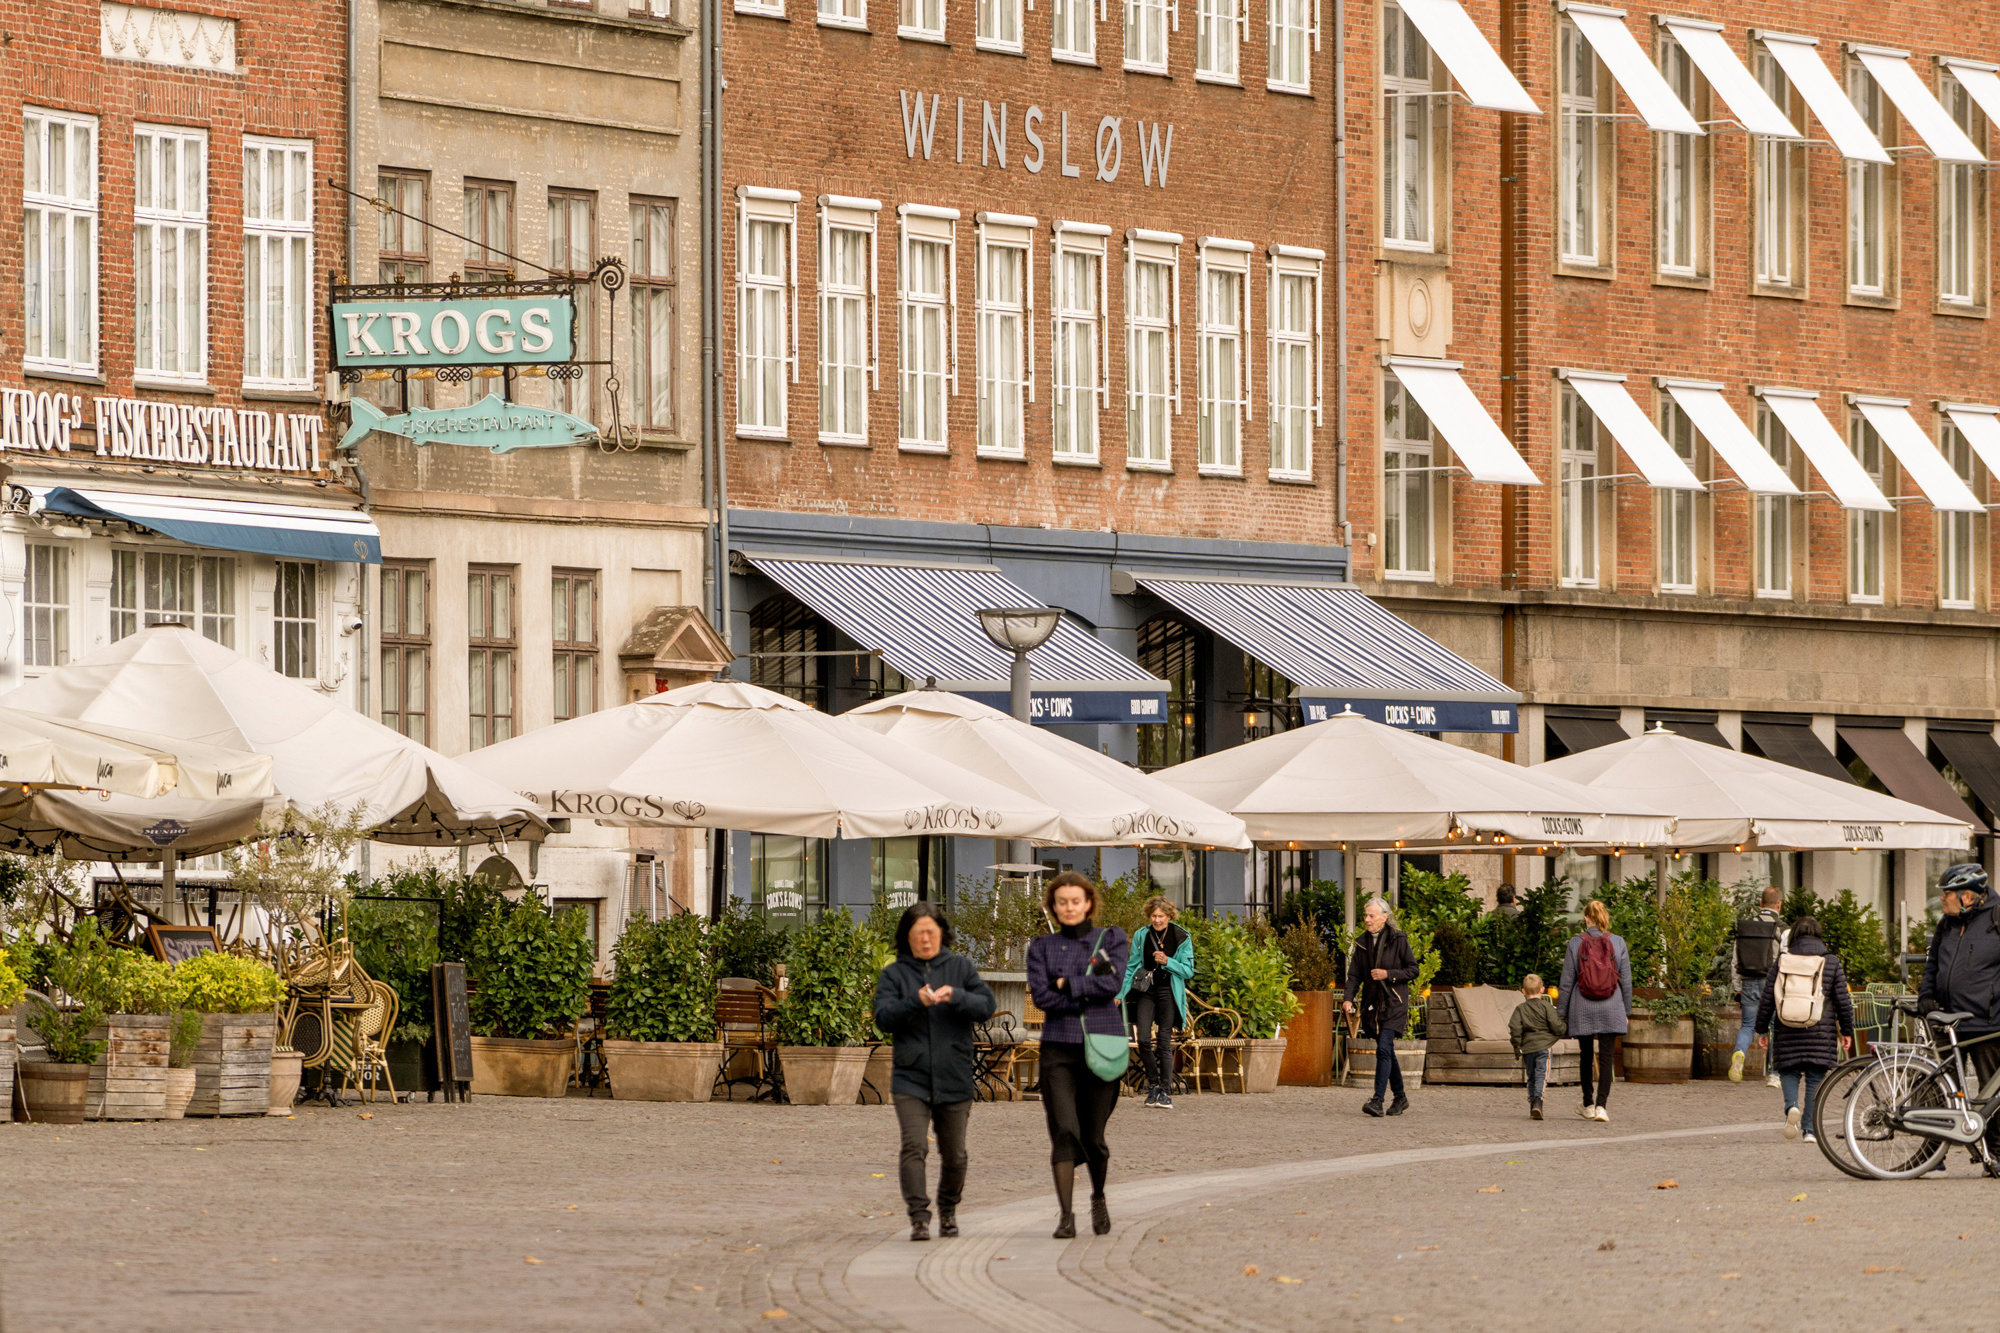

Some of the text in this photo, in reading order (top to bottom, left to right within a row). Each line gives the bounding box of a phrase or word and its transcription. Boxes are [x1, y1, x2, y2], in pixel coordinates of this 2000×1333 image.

[900, 89, 1173, 188] WINSLØW
[342, 308, 554, 357] KROGS
[93, 396, 324, 472] FISKERESTAURANT
[401, 414, 555, 434] FISKERESTAURANT
[1050, 697, 1073, 717] COWS
[1385, 705, 1409, 725] COCKS
[1415, 706, 1436, 725] COWS
[551, 789, 665, 819] KROGS
[922, 805, 981, 830] KROGS
[1126, 812, 1179, 837] KROGS
[1541, 817, 1562, 835] COCKS
[1564, 817, 1584, 836] COWS
